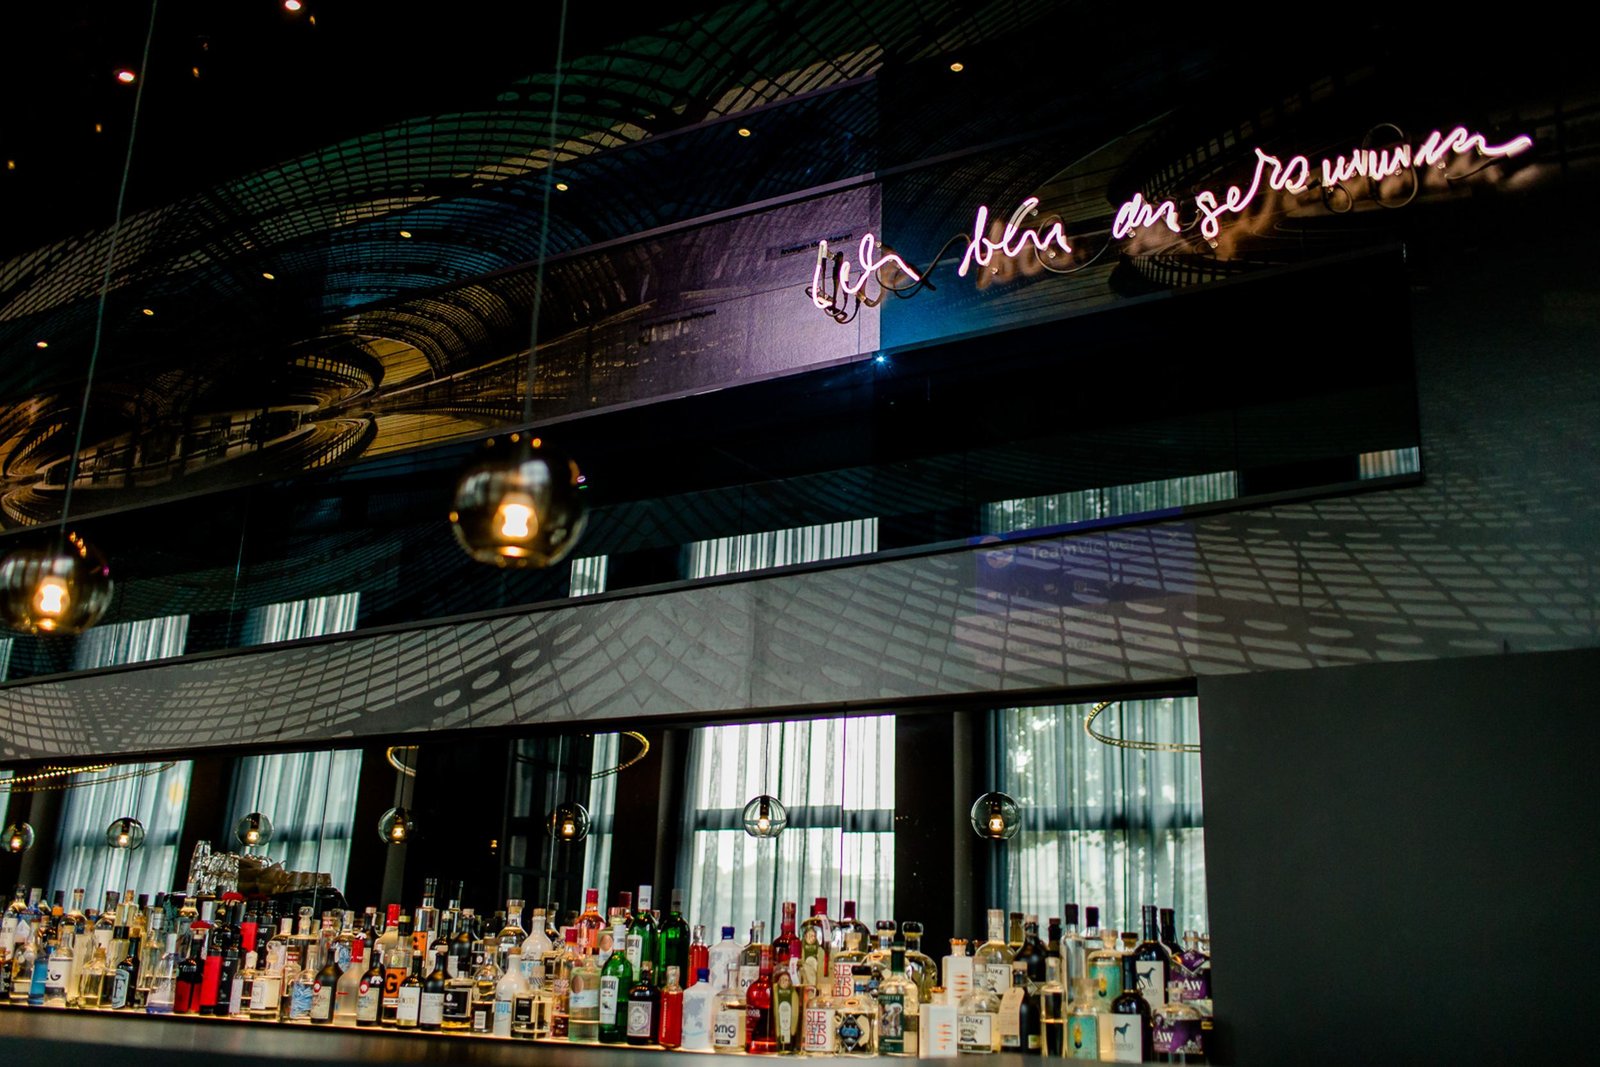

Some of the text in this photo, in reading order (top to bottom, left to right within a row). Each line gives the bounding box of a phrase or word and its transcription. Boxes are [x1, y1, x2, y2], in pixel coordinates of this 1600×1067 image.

[813, 232, 920, 309] Ich
[957, 197, 1072, 277] bin
[806, 1010, 826, 1024] SIE
[965, 1016, 983, 1025] DUKE
[714, 1024, 736, 1039] omg
[1153, 1031, 1175, 1043] AW
